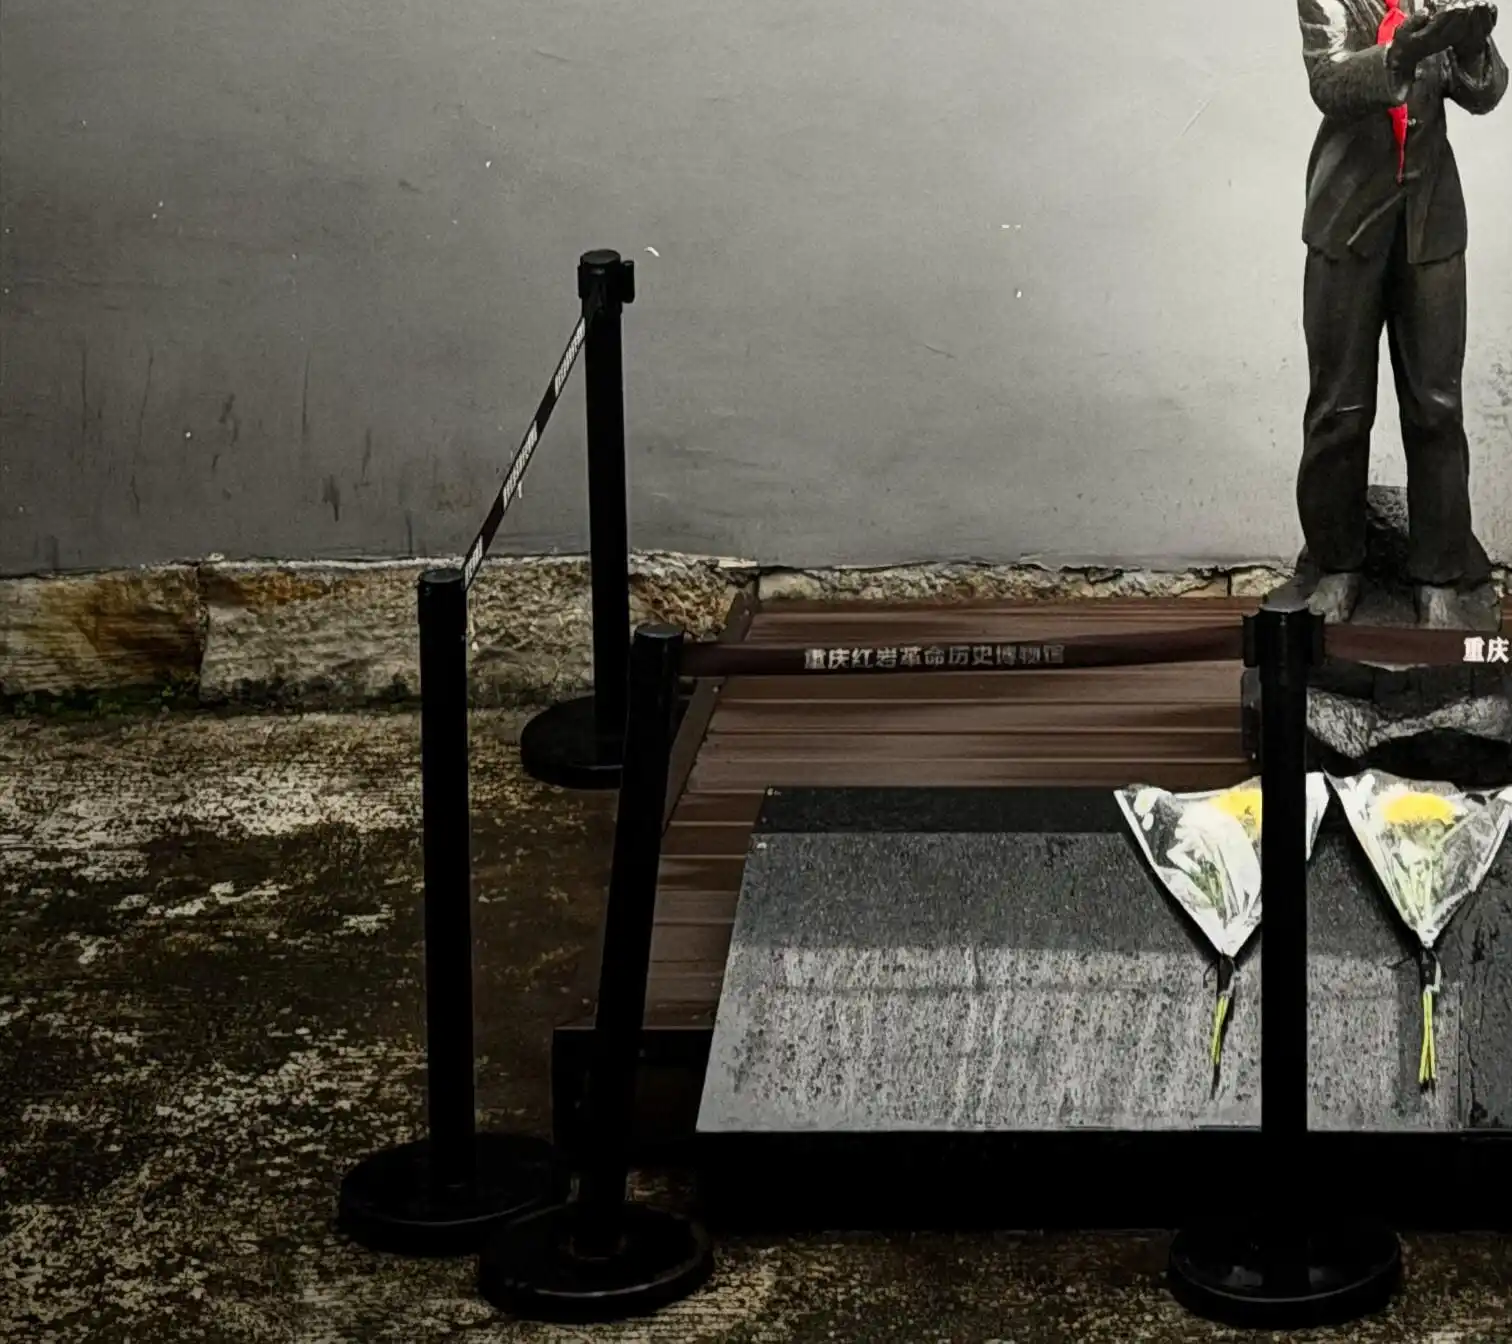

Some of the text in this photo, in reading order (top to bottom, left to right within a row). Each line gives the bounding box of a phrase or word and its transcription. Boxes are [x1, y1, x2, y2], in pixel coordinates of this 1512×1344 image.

[803, 644, 1066, 670] 重庆红岩革命历史博物馆
